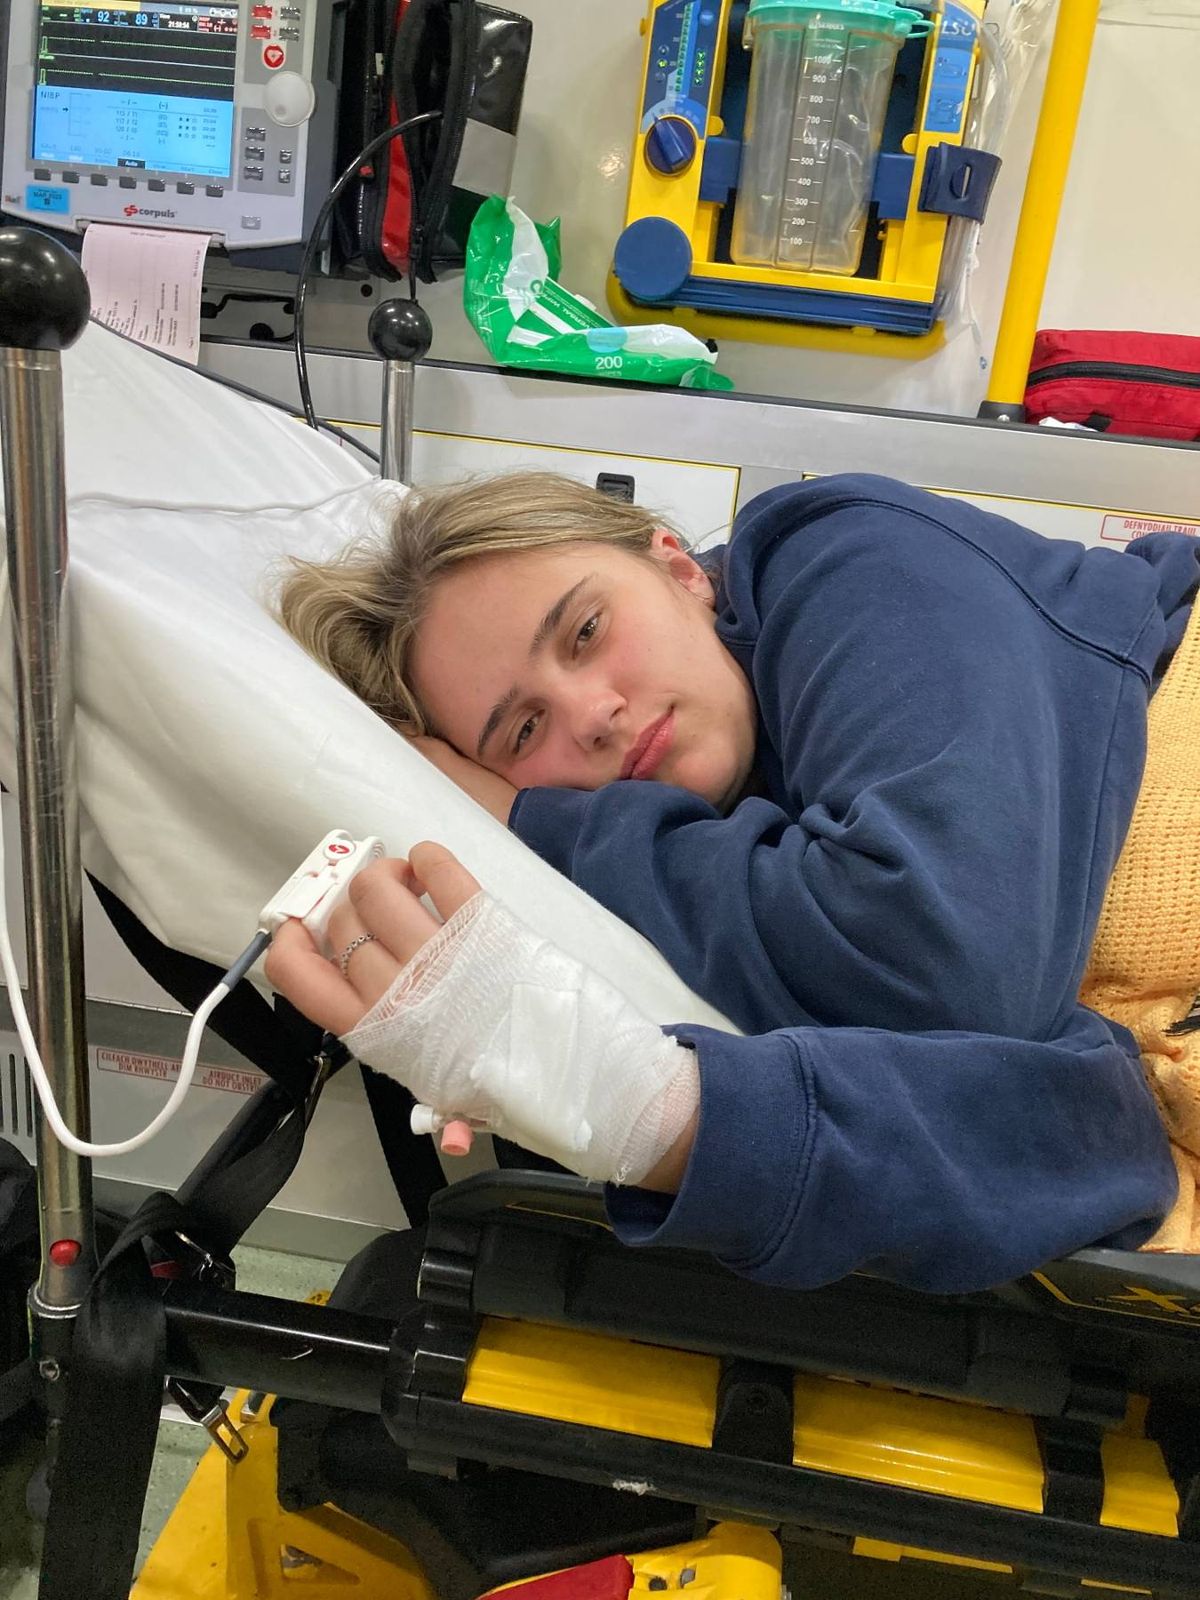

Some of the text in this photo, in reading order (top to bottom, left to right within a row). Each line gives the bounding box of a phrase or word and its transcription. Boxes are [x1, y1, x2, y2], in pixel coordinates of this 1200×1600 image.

[97, 11, 110, 23] 92
[135, 13, 148, 26] 89
[812, 74, 827, 83] 900
[807, 115, 821, 124] 700
[803, 136, 818, 145] 600
[800, 157, 814, 166] 500
[797, 178, 811, 187] 400
[794, 198, 808, 206] 300
[138, 207, 175, 218] corpuls
[791, 217, 806, 226] 200
[790, 237, 803, 246] 100
[595, 356, 623, 370] 200
[215, 1079, 229, 1088] NOT
